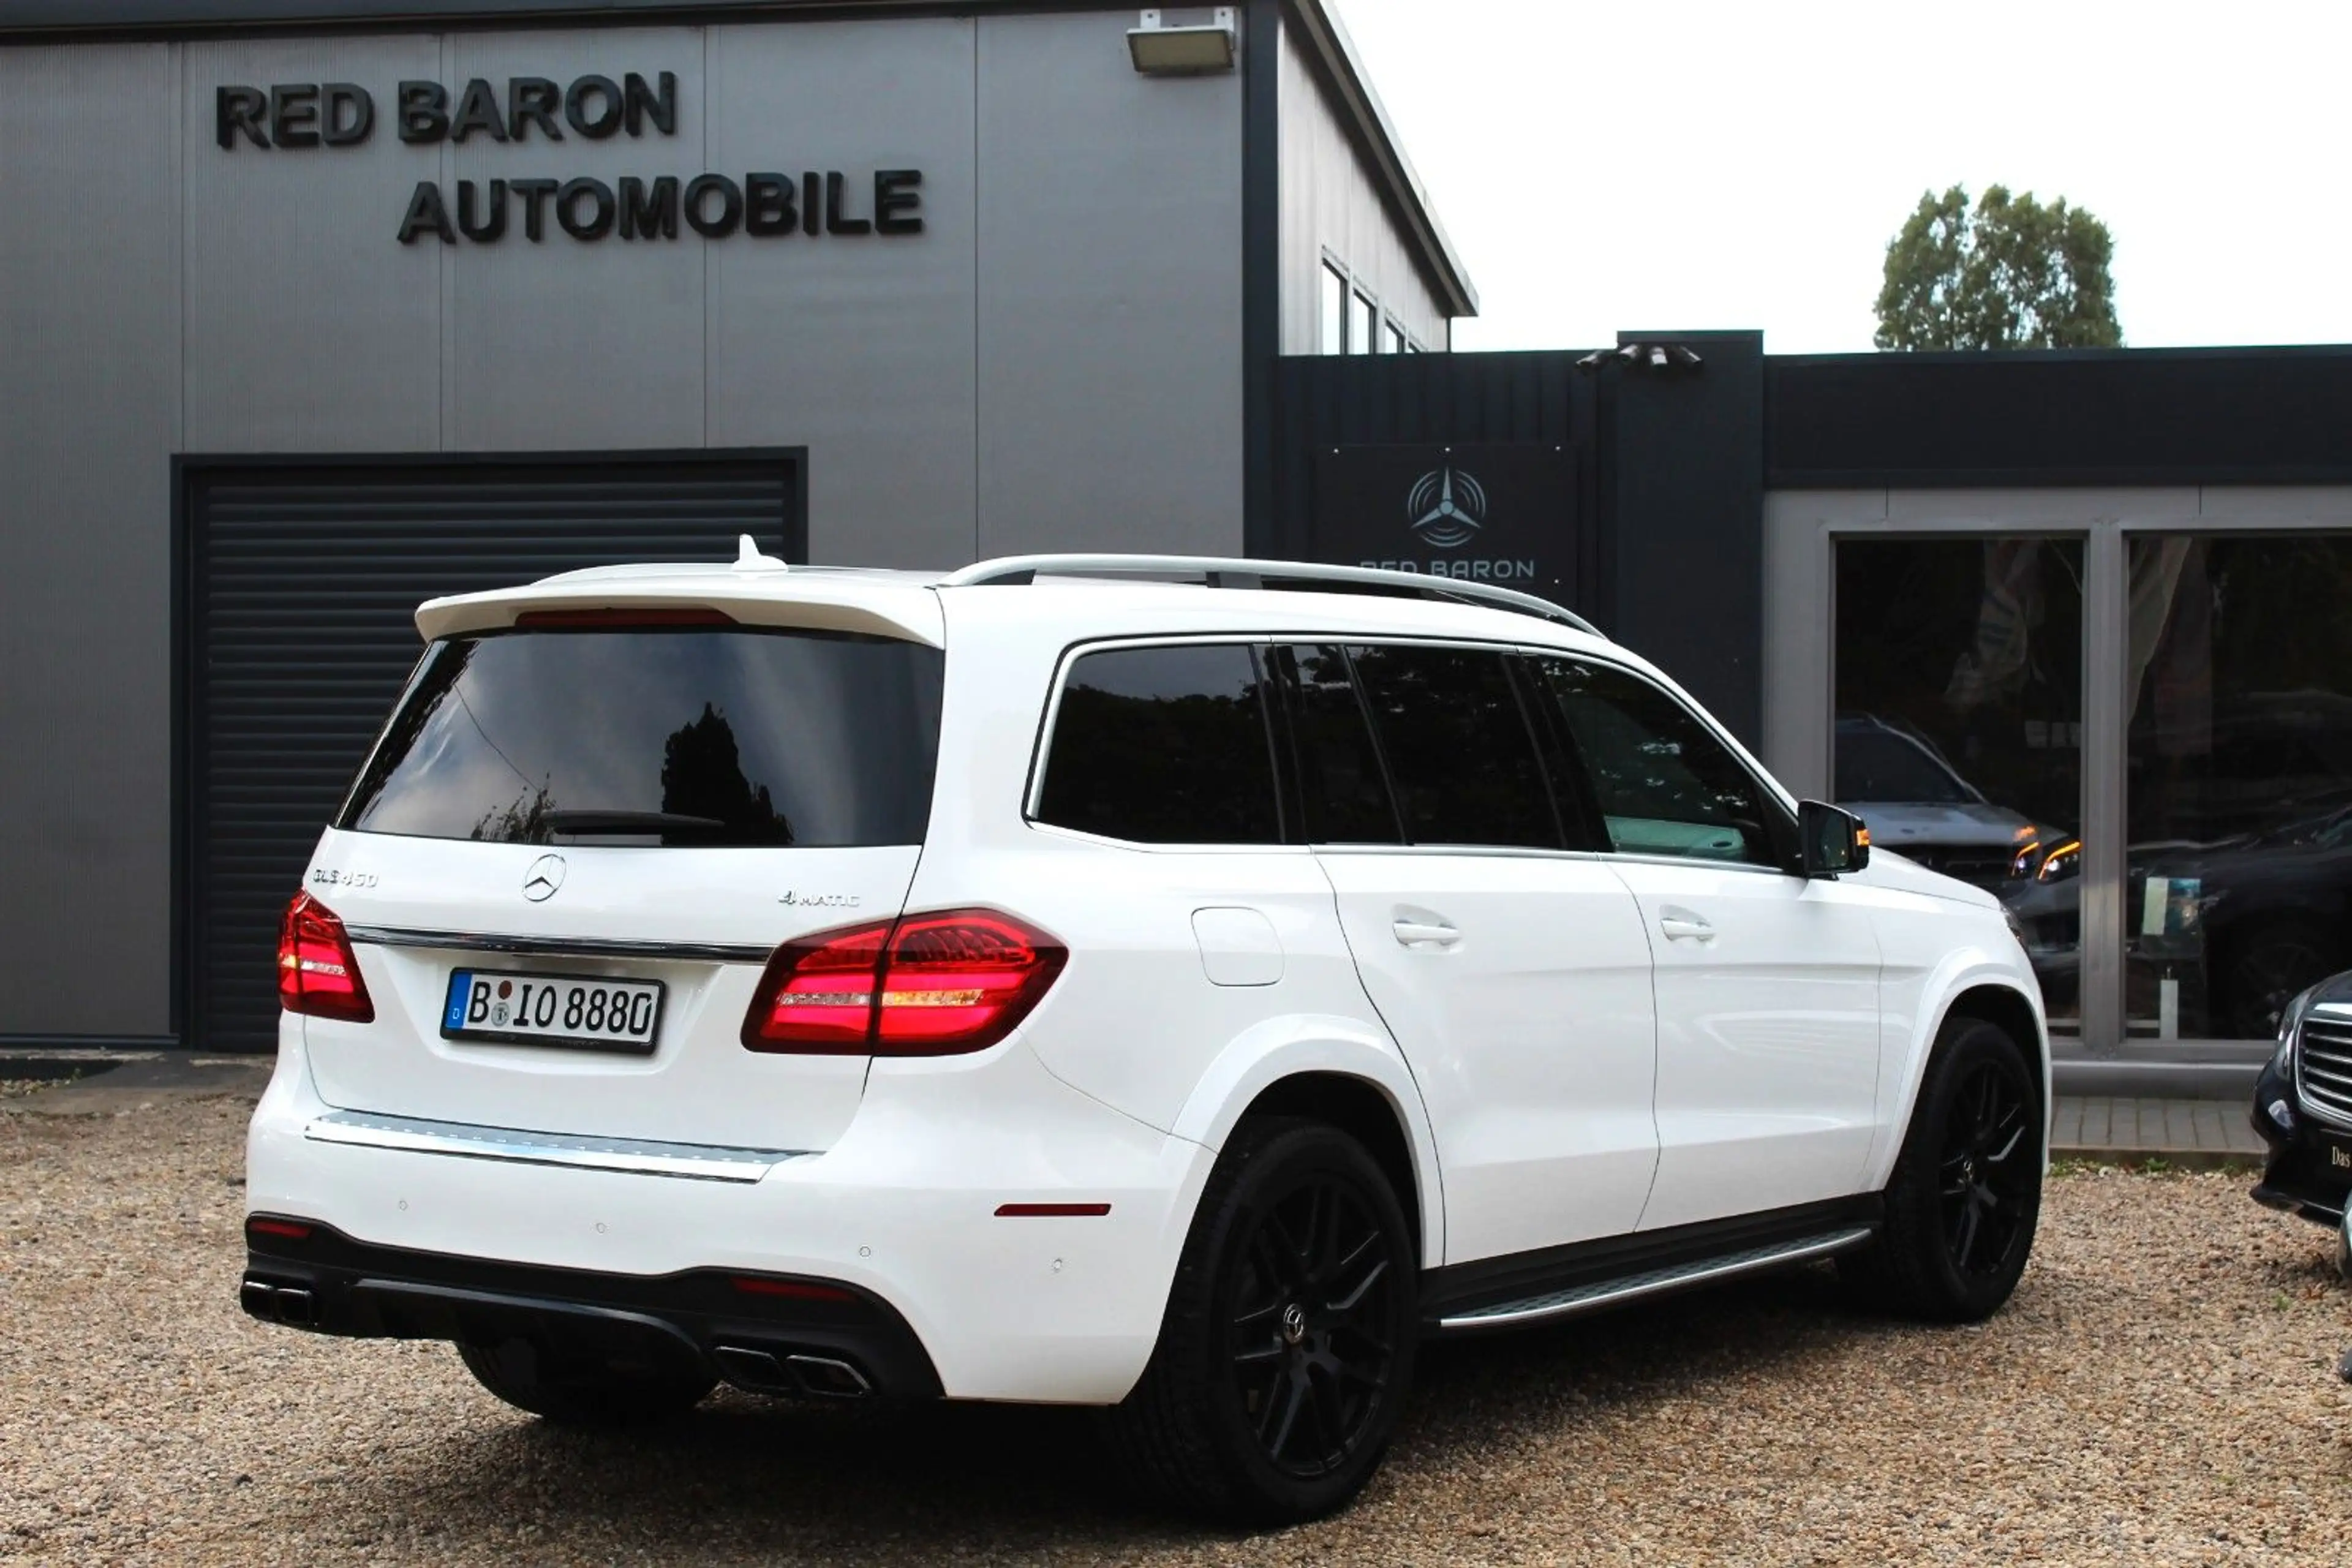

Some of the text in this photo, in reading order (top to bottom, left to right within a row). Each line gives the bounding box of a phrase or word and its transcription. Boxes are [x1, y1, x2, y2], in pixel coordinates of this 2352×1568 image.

[217, 70, 677, 149] RED BARON
[397, 170, 923, 243] AUTOMOBILE
[1431, 560, 1534, 578] BARON
[468, 981, 491, 1023] B
[564, 987, 652, 1035] 8880
[2331, 1146, 2350, 1168] Das
